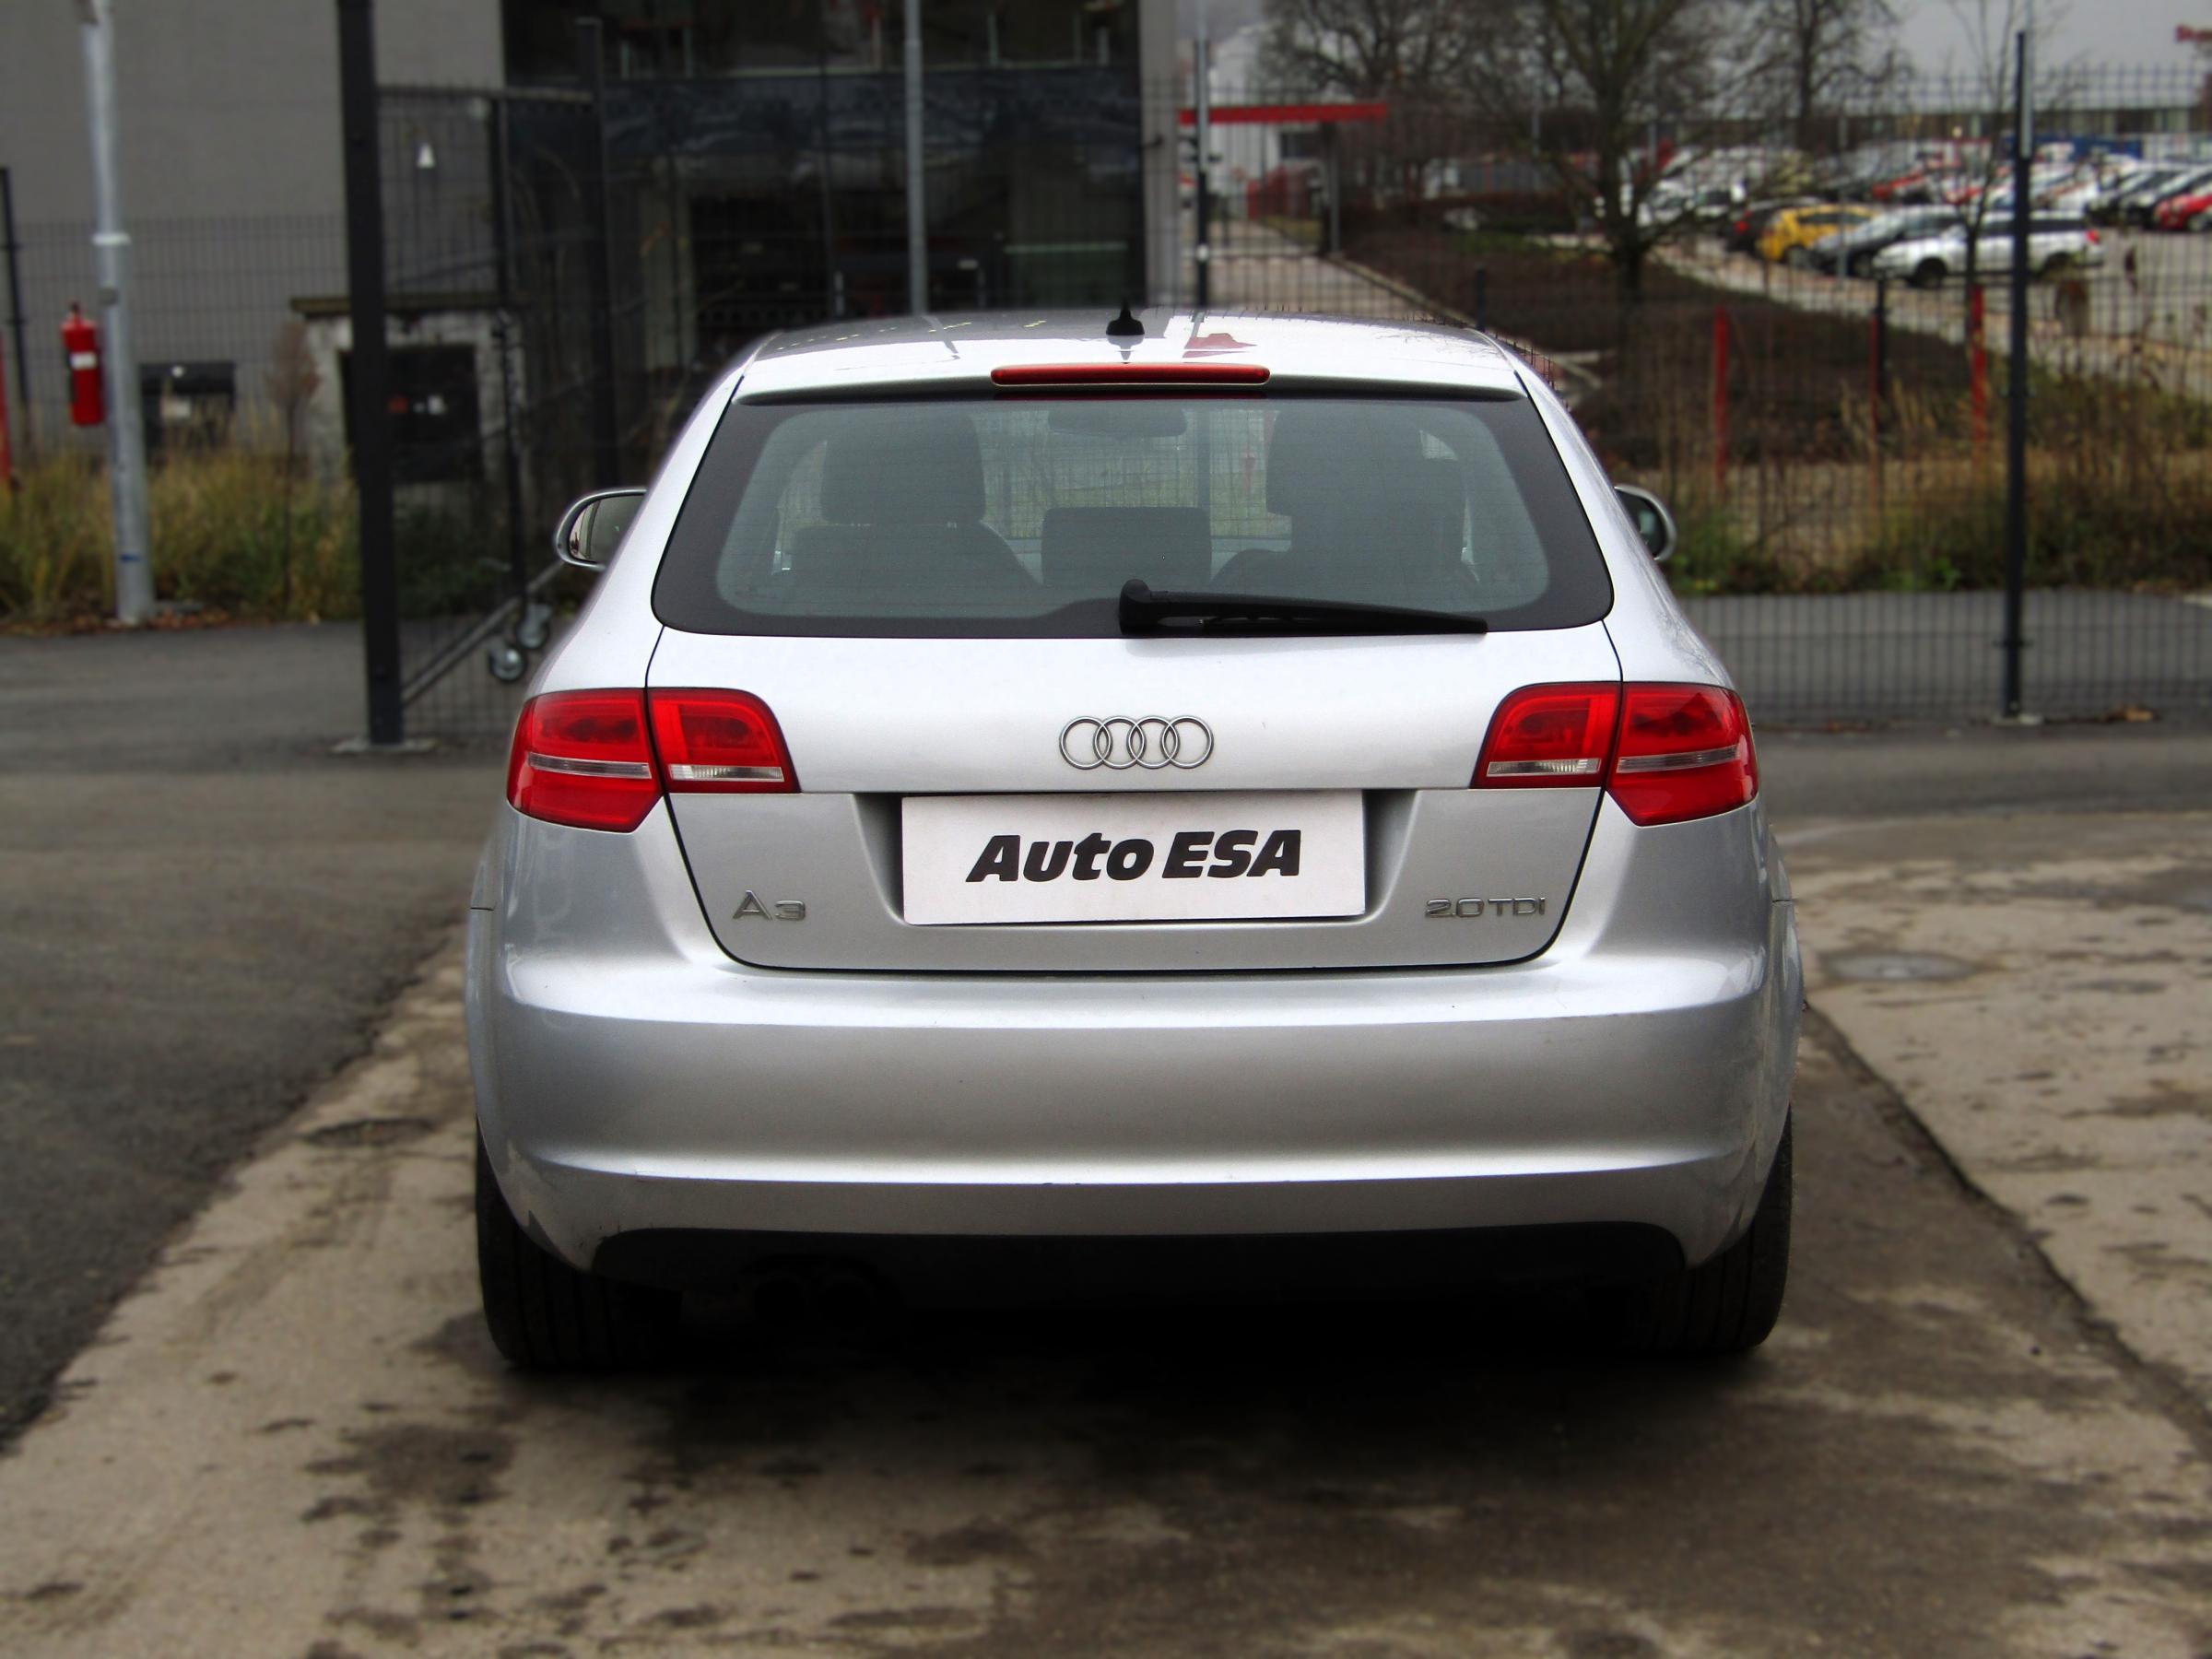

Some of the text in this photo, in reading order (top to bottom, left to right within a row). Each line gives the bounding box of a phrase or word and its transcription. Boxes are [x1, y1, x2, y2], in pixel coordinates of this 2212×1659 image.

[965, 830, 1301, 882] Auto ESA
[732, 888, 806, 922] A3
